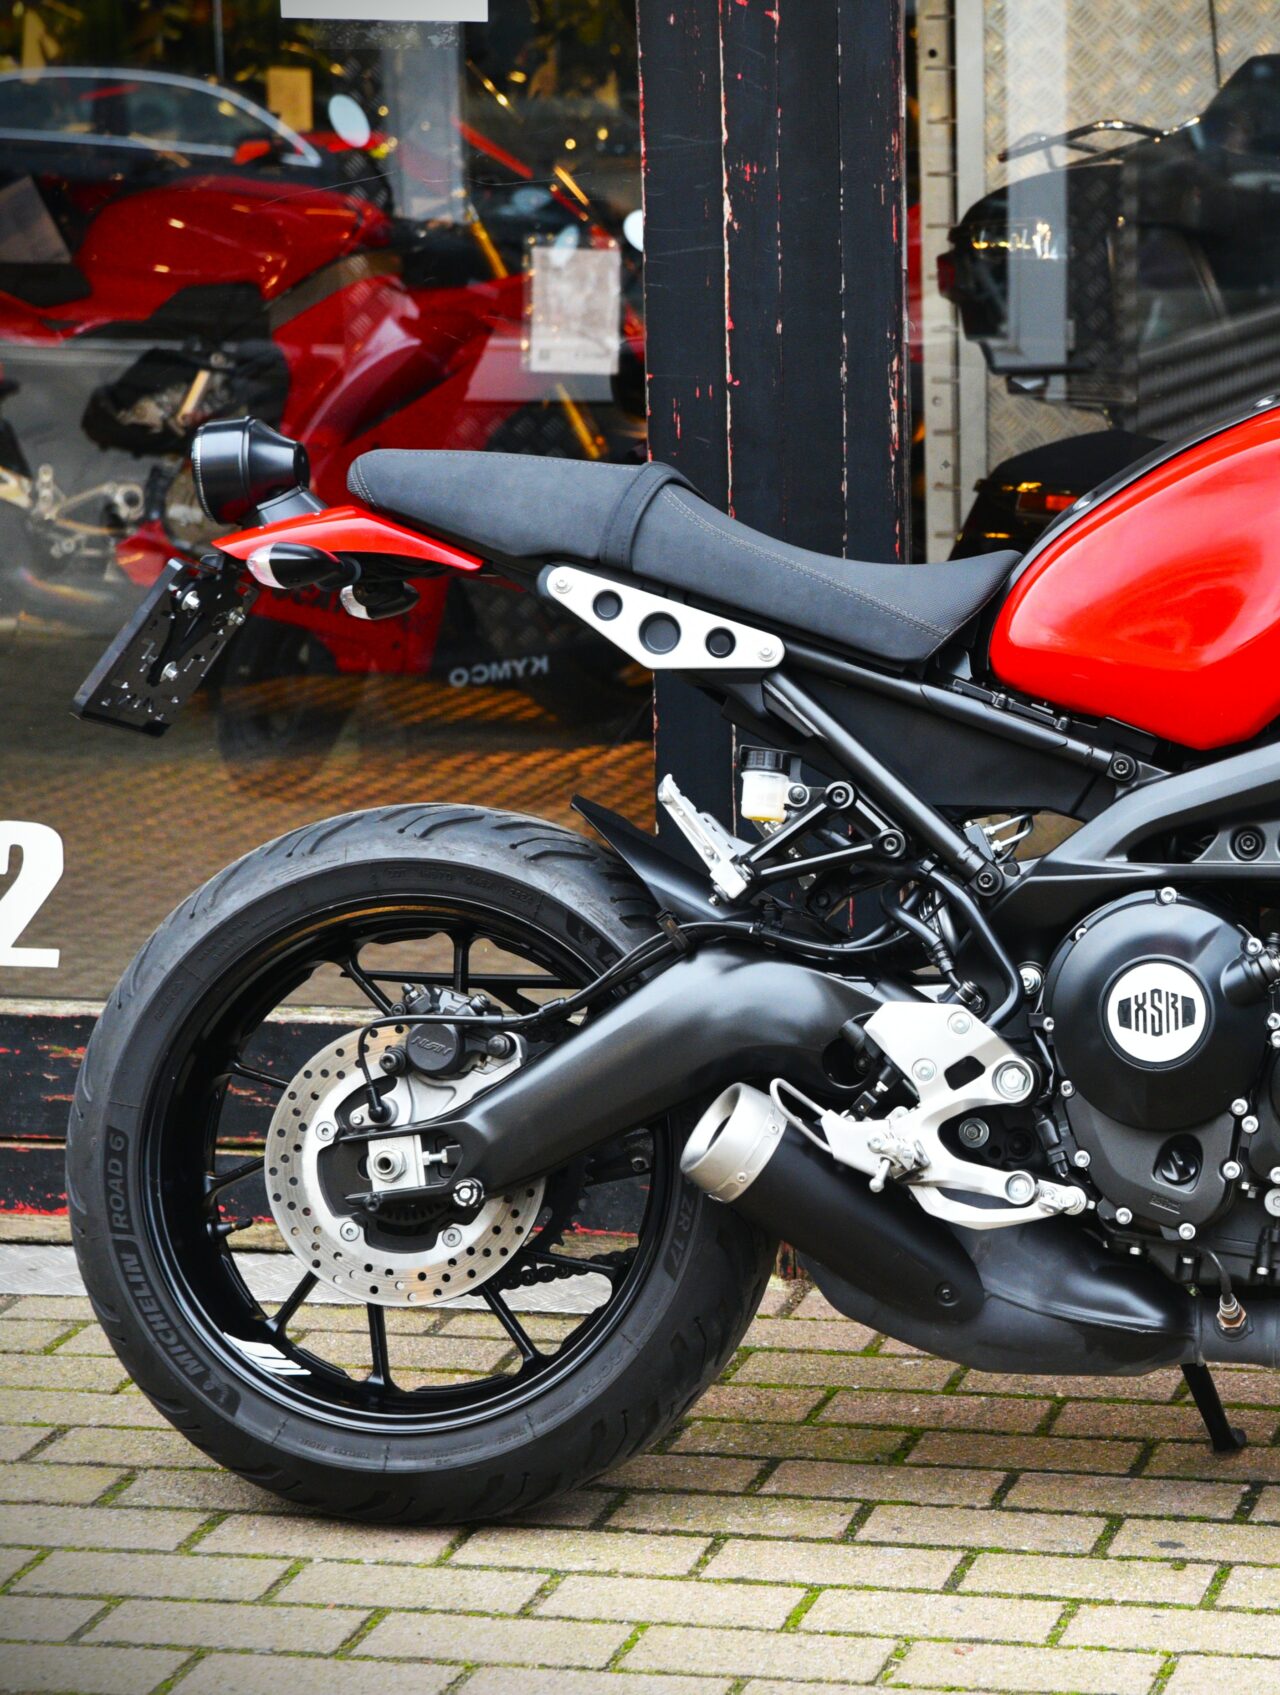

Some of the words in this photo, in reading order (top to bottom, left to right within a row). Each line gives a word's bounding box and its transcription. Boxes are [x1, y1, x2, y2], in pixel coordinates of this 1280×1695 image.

[0, 820, 64, 968] 2
[1134, 988, 1179, 1037] XSR
[110, 1133, 124, 1151] 6
[108, 1158, 128, 1229] ROAD
[678, 1194, 693, 1232] ZR
[670, 1239, 685, 1268] 17
[121, 1253, 204, 1377] MICHELIN
